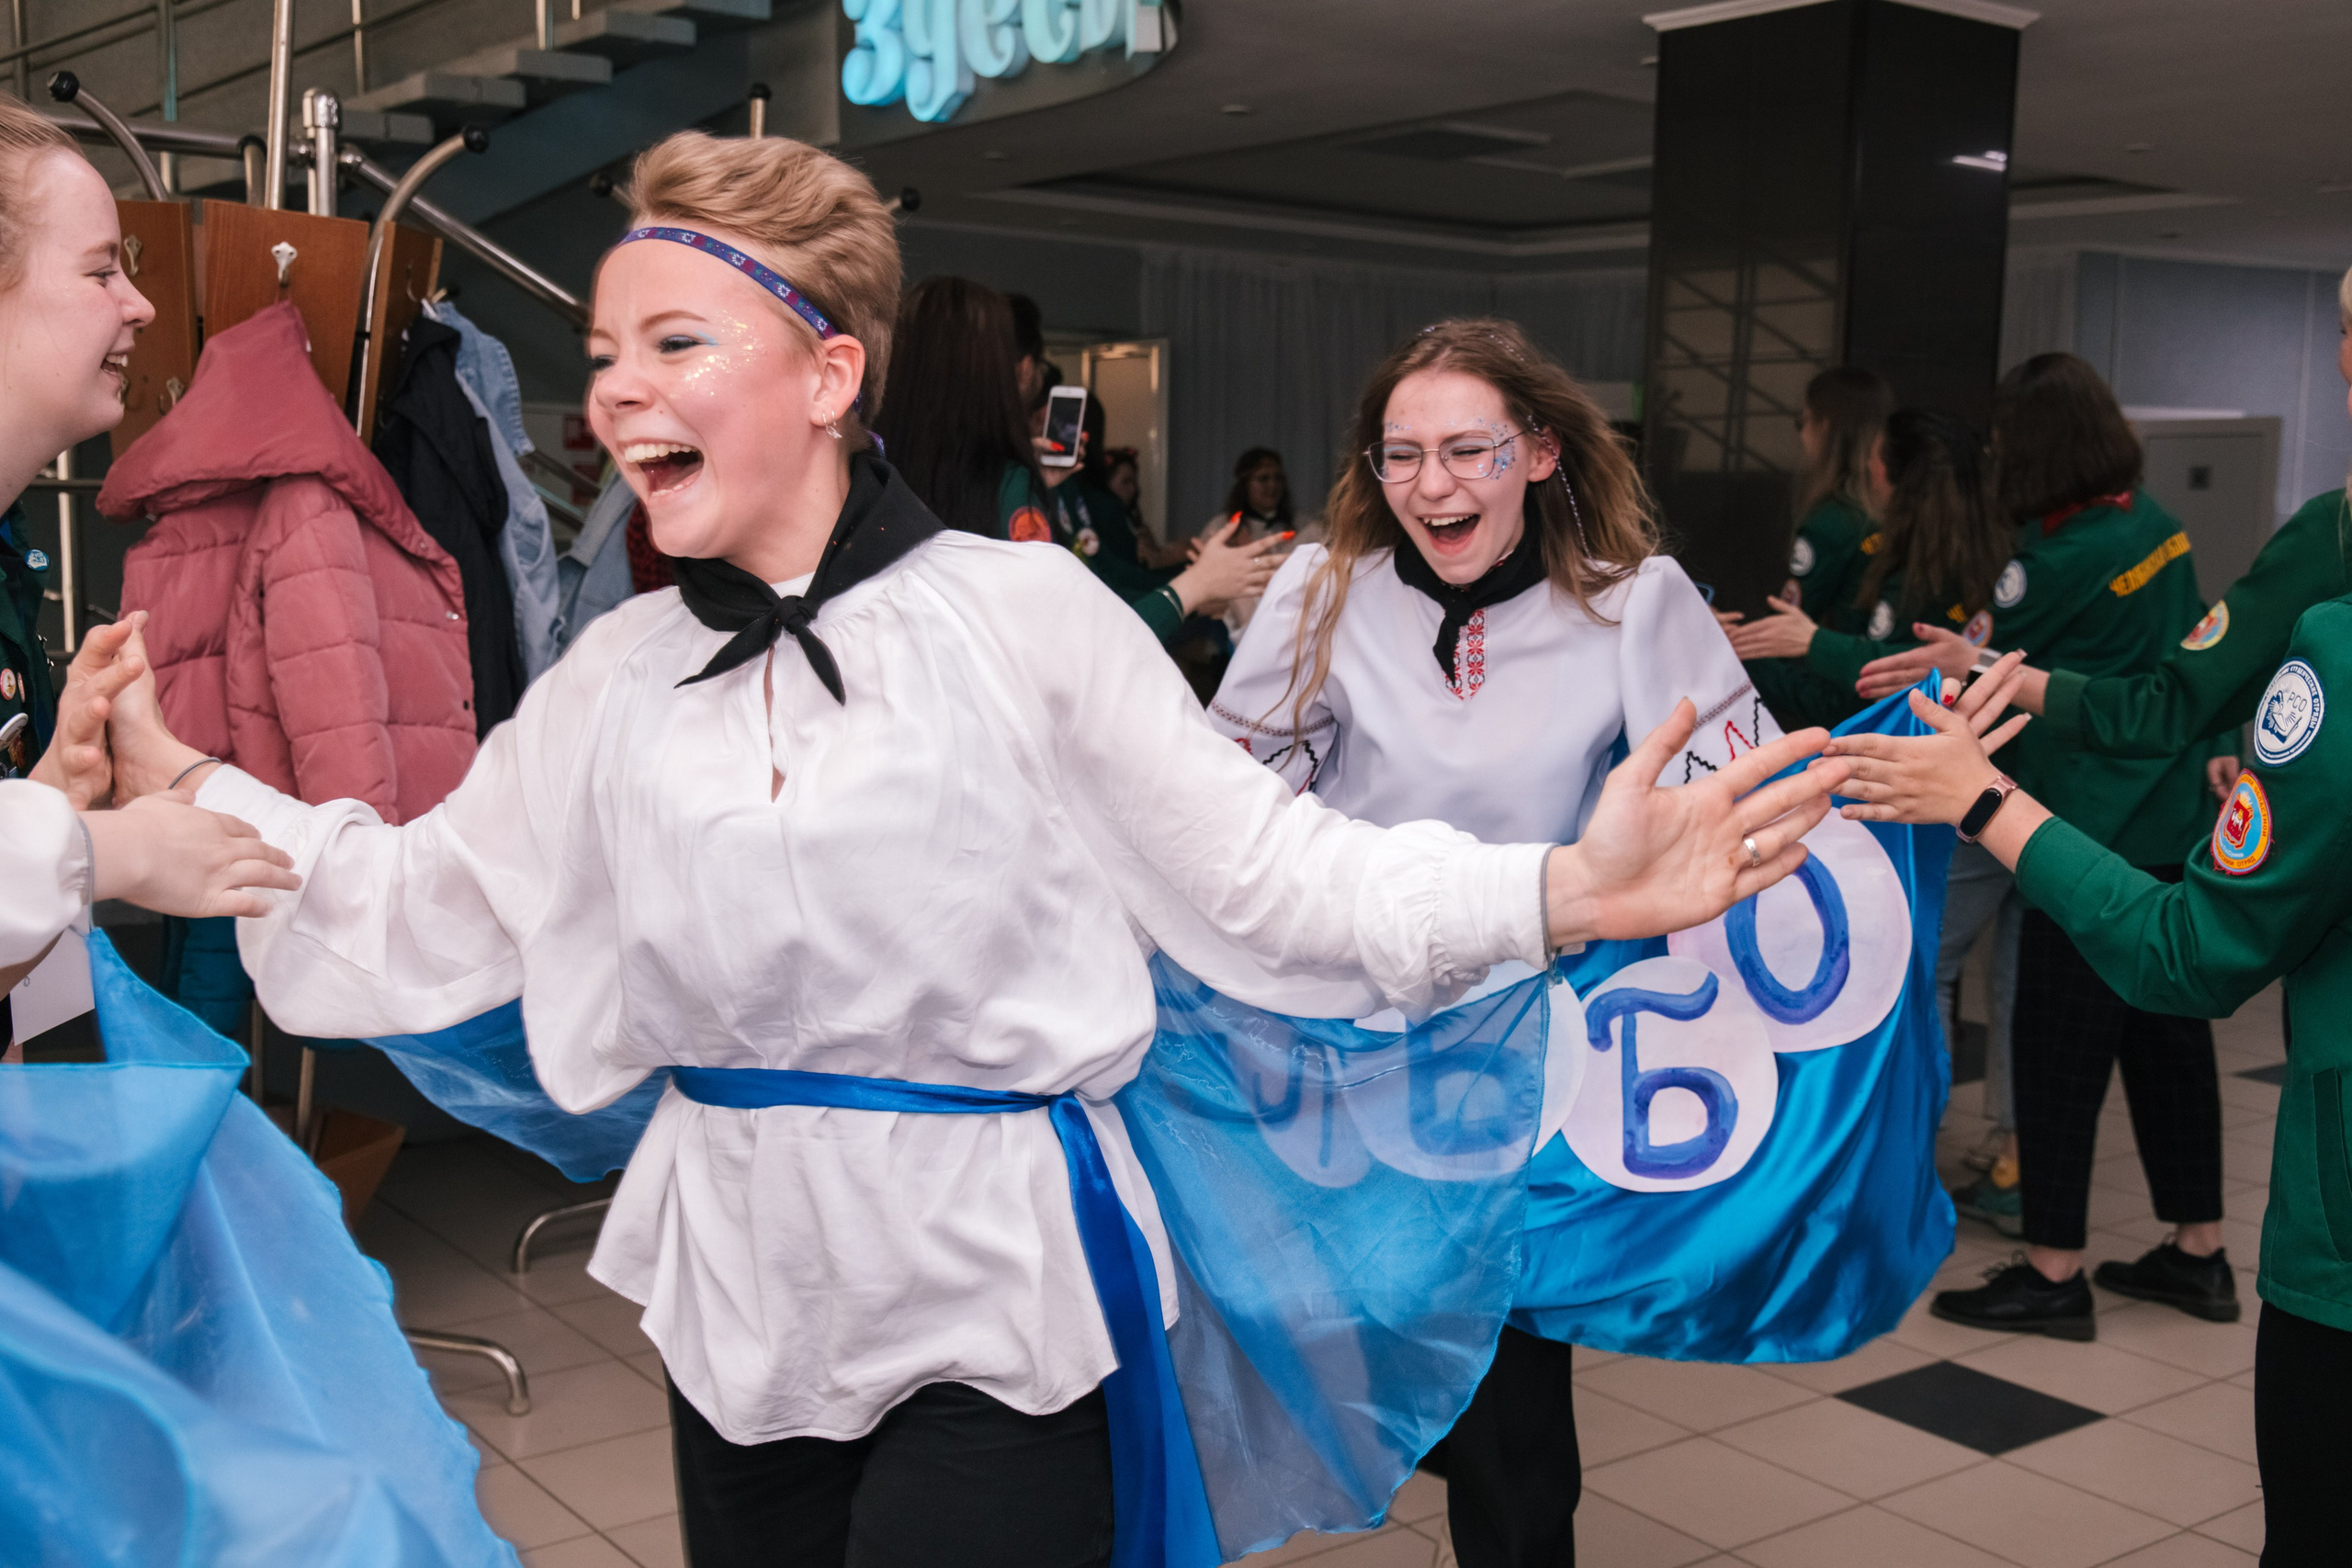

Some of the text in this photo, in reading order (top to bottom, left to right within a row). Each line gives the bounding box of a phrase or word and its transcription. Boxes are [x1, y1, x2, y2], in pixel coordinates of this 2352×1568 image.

[2287, 691, 2308, 713] РСО
[2309, 698, 2320, 728] ОТРЯДЫ
[2236, 855, 2256, 868] ОТРЯД
